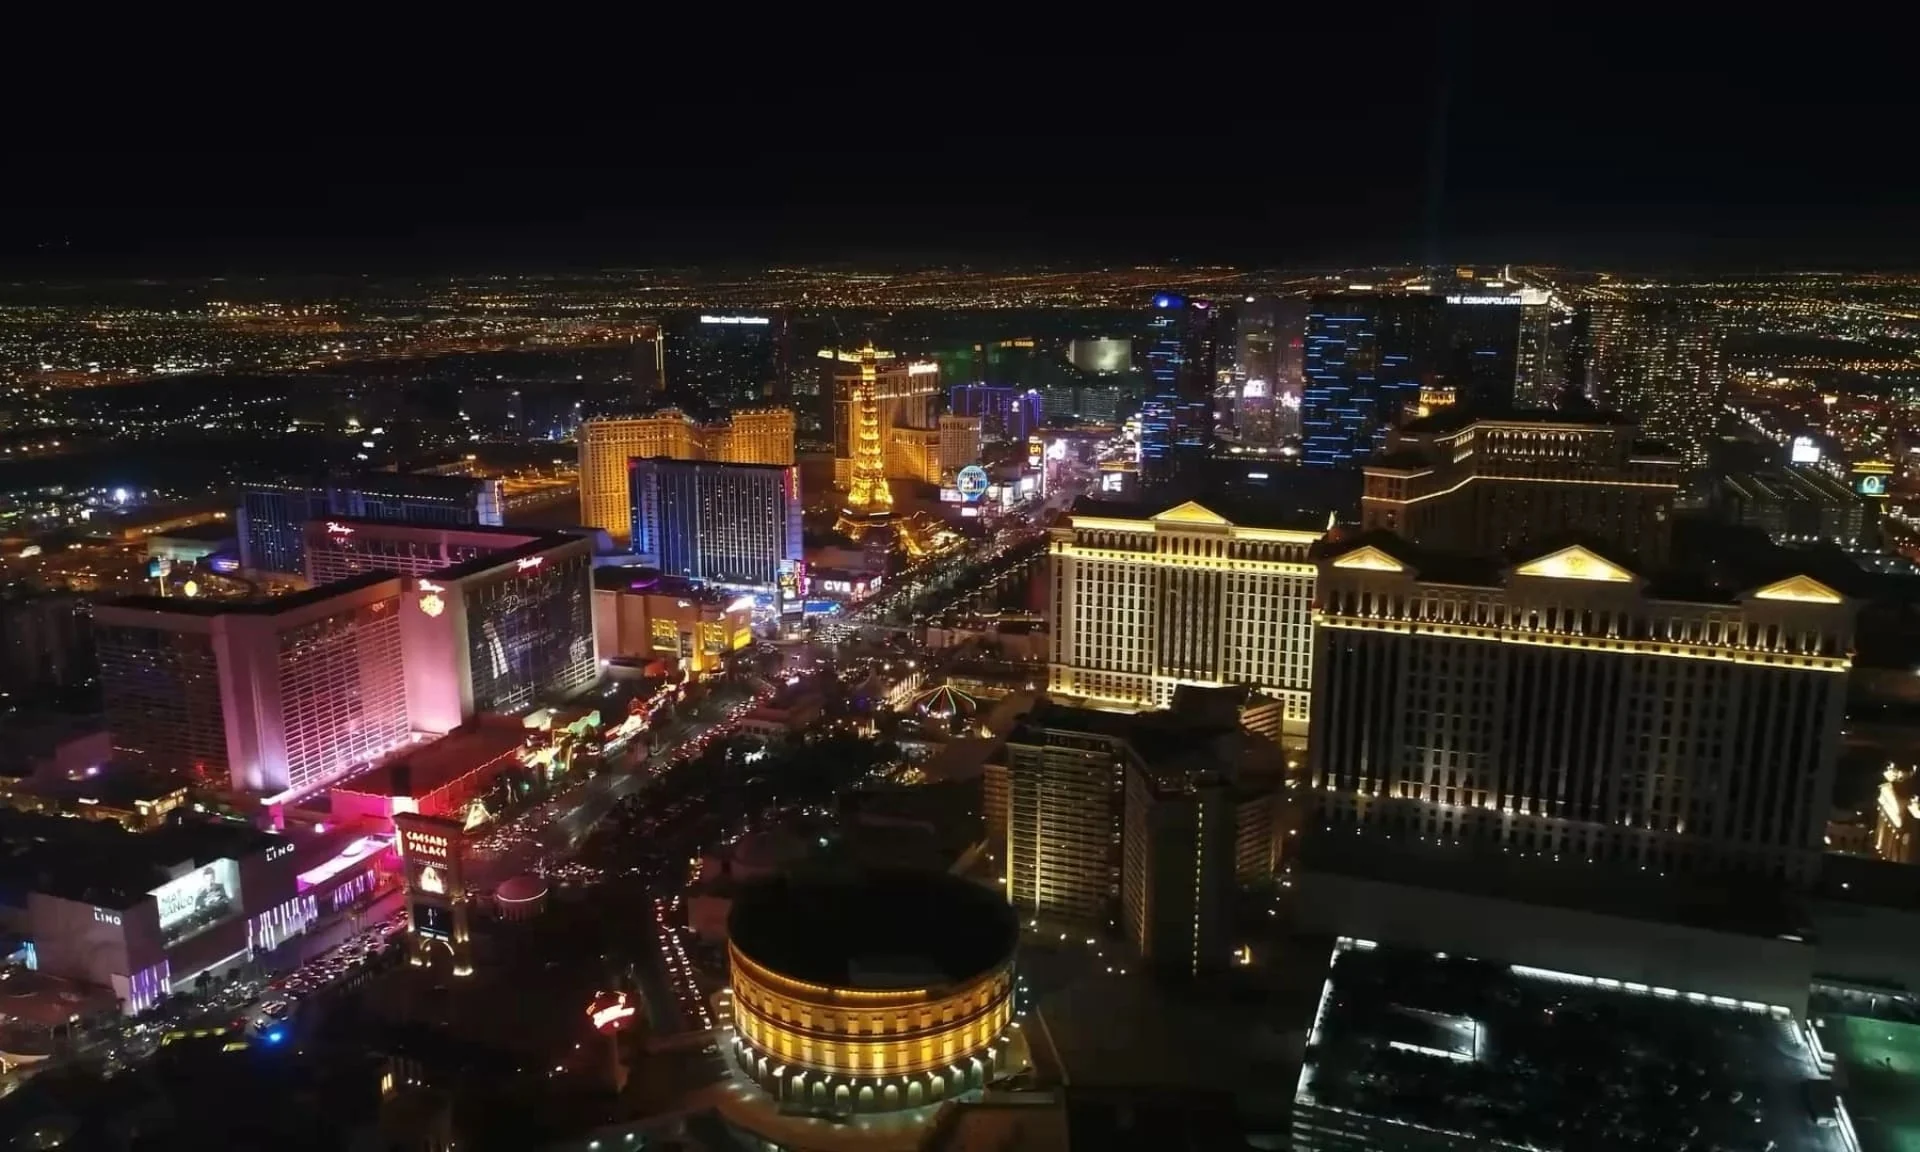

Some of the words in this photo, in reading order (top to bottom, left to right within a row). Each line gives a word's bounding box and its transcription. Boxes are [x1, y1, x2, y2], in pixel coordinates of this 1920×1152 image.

[1446, 295, 1461, 305] THE
[1463, 296, 1520, 305] COSMOPOLITAN
[823, 580, 851, 592] CVS
[406, 831, 448, 847] CAESARS
[409, 842, 447, 858] PALACE
[94, 911, 121, 925] LINQ
